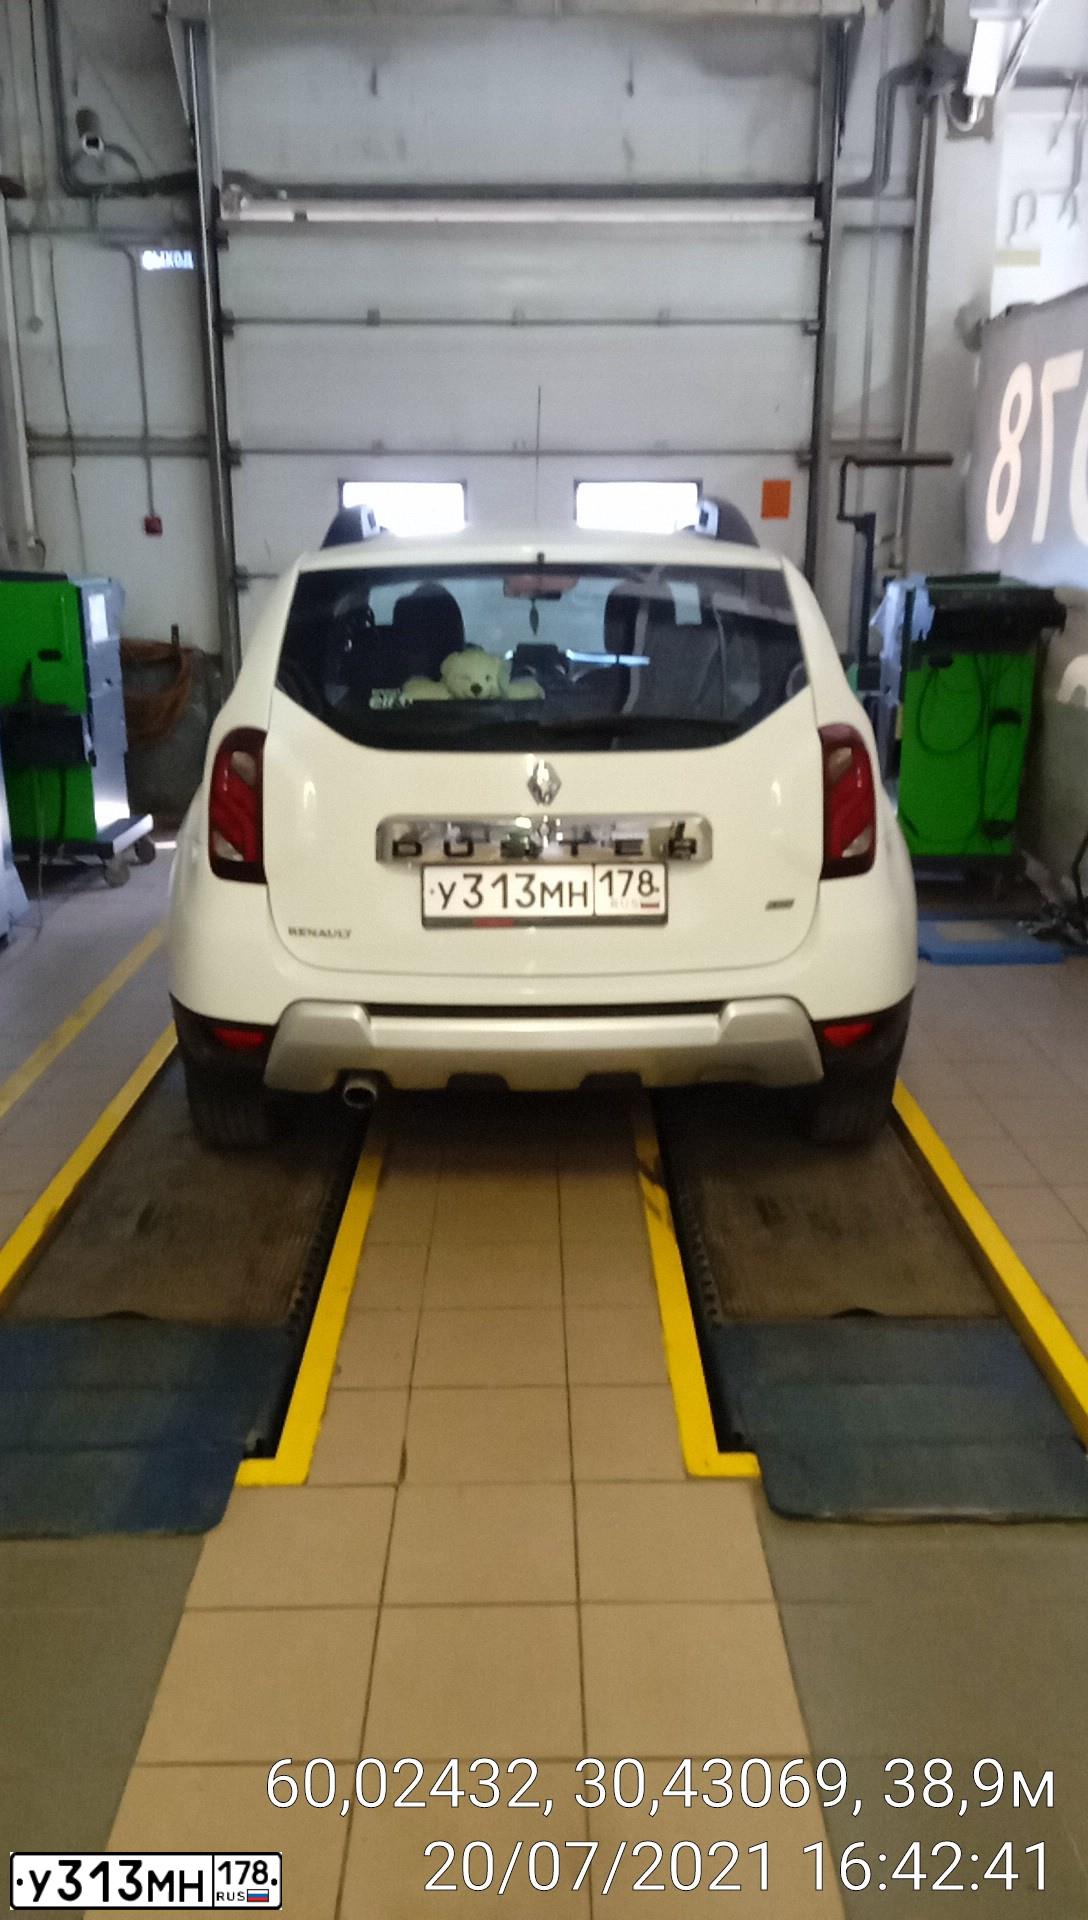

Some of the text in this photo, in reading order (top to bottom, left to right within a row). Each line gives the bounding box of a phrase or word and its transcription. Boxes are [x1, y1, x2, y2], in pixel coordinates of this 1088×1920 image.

[437, 869, 655, 911] У313МН 178
[287, 926, 352, 939] RENAULT
